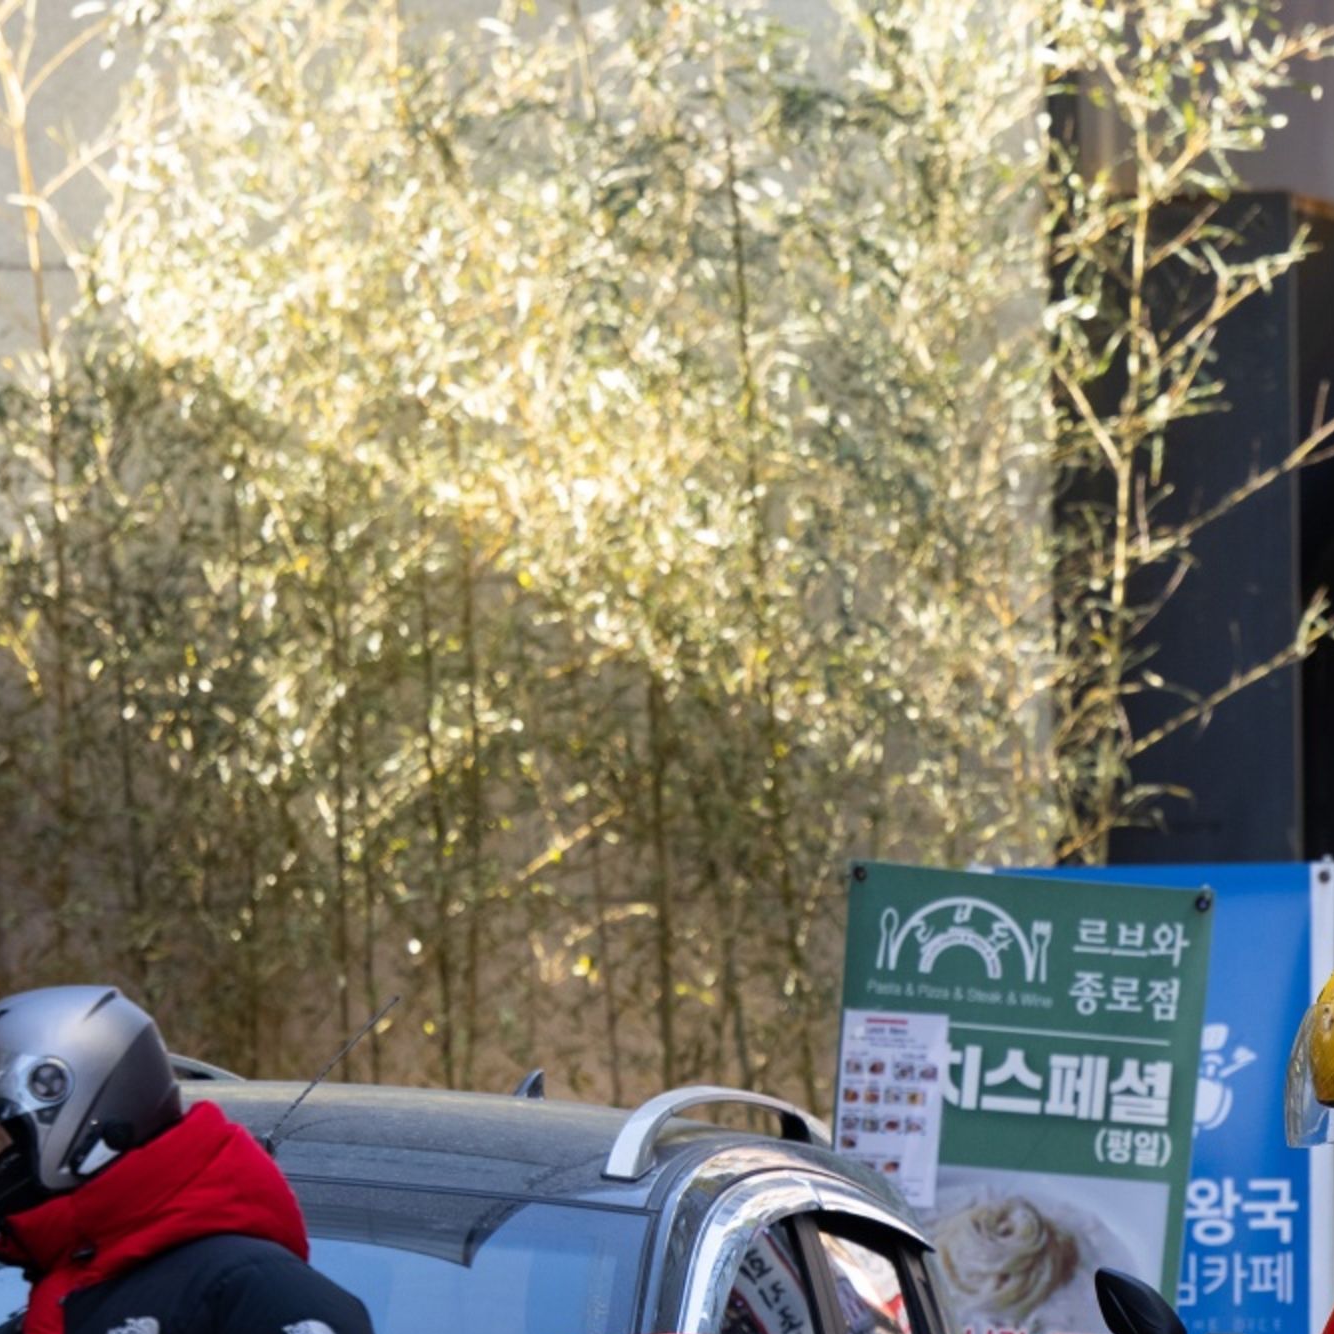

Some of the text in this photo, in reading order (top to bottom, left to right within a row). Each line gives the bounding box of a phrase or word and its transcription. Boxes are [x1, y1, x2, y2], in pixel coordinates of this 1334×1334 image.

[1073, 917, 1190, 968] 르브와
[1069, 970, 1181, 1022] 종로점
[1095, 1128, 1172, 1168] (평일)
